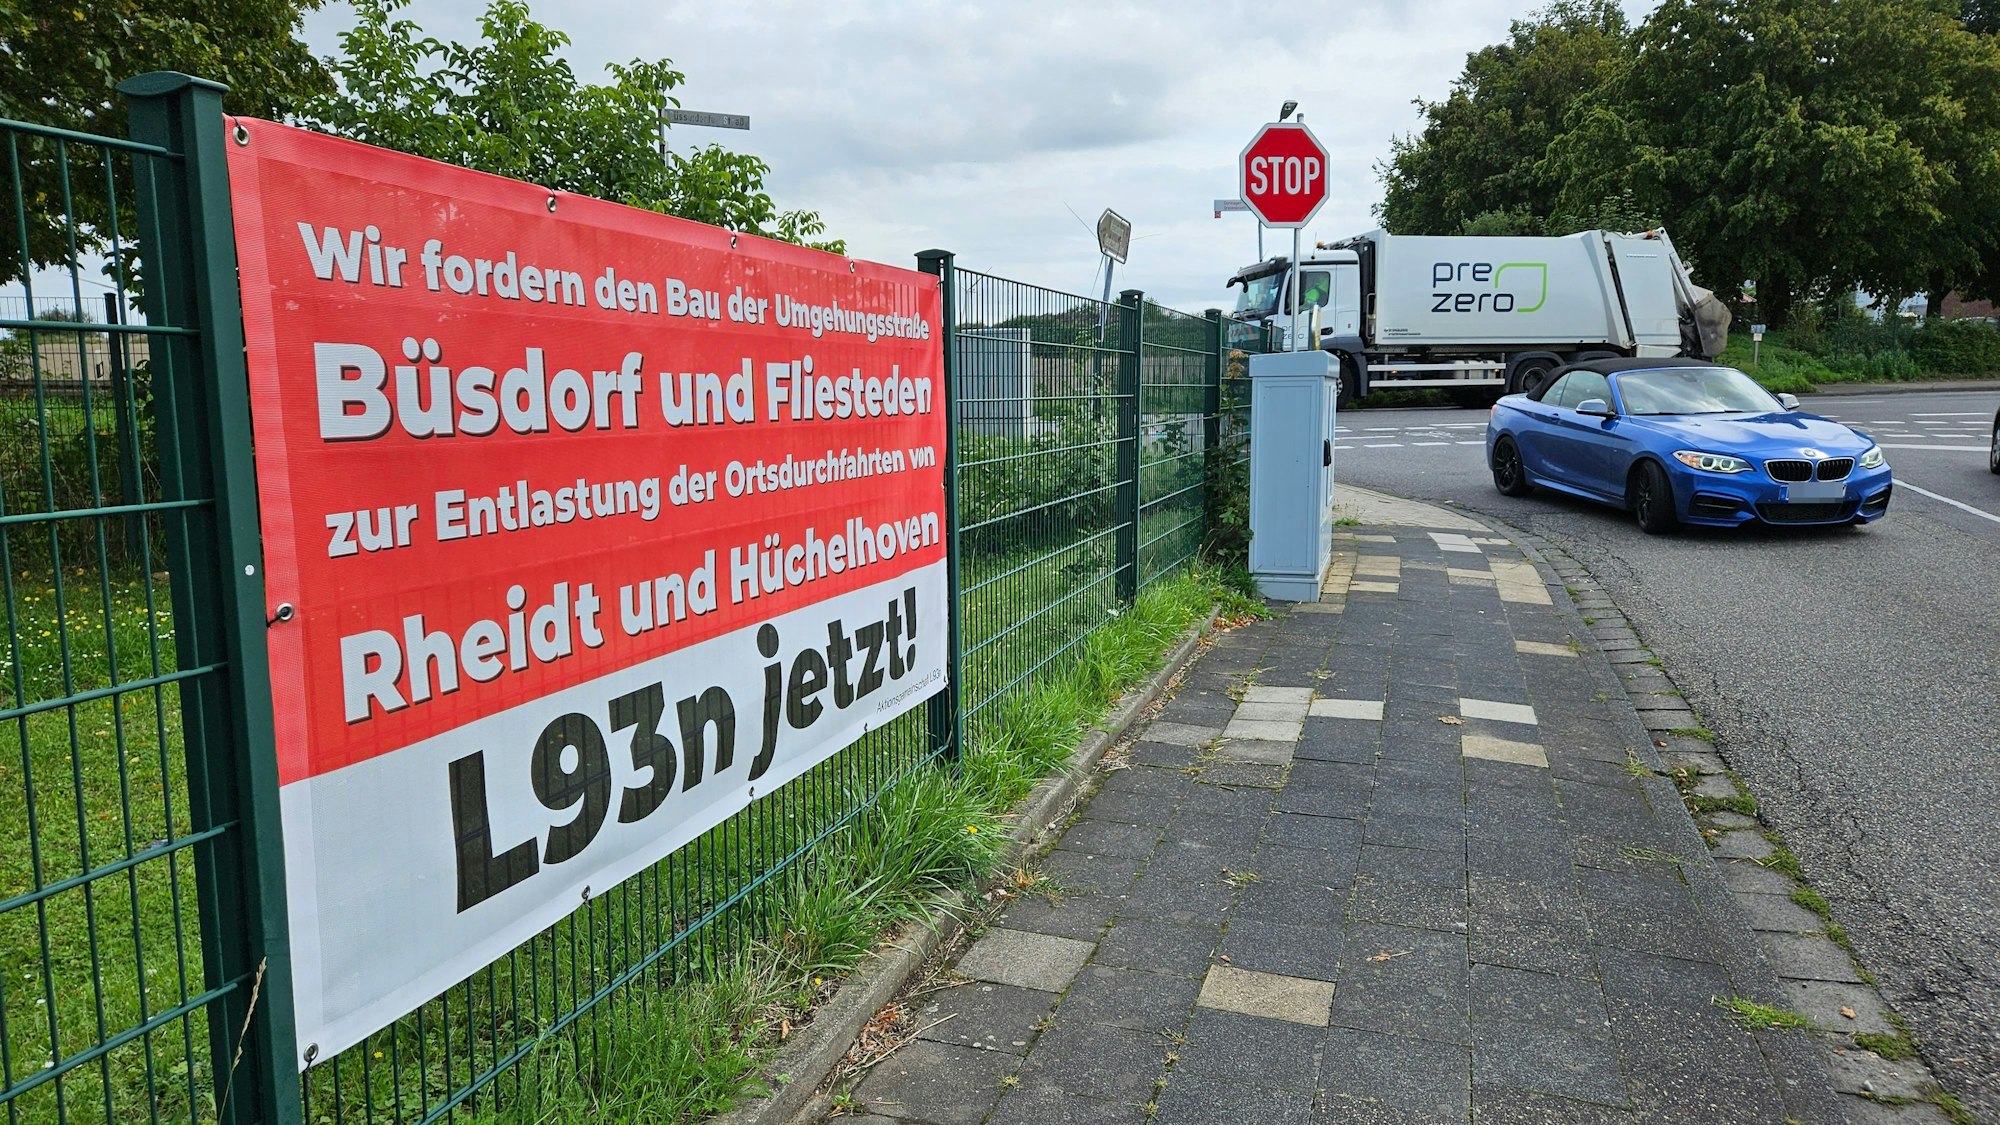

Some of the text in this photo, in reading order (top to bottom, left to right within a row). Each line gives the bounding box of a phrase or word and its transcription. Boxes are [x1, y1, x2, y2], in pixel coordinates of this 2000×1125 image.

[1250, 155, 1321, 196] STOP
[297, 222, 930, 343] Wir fordern den Bau der Umgehungsstraße
[1431, 293, 1515, 312] zero
[1432, 262, 1493, 289] pre
[313, 336, 933, 442] Büsdorf und Fliesteden
[325, 445, 936, 559] zur Entlastung der Ortsdurchfahrten von
[340, 511, 939, 726] Rheidt und Hüchelhoven
[448, 587, 917, 915] L93n jetzt!
